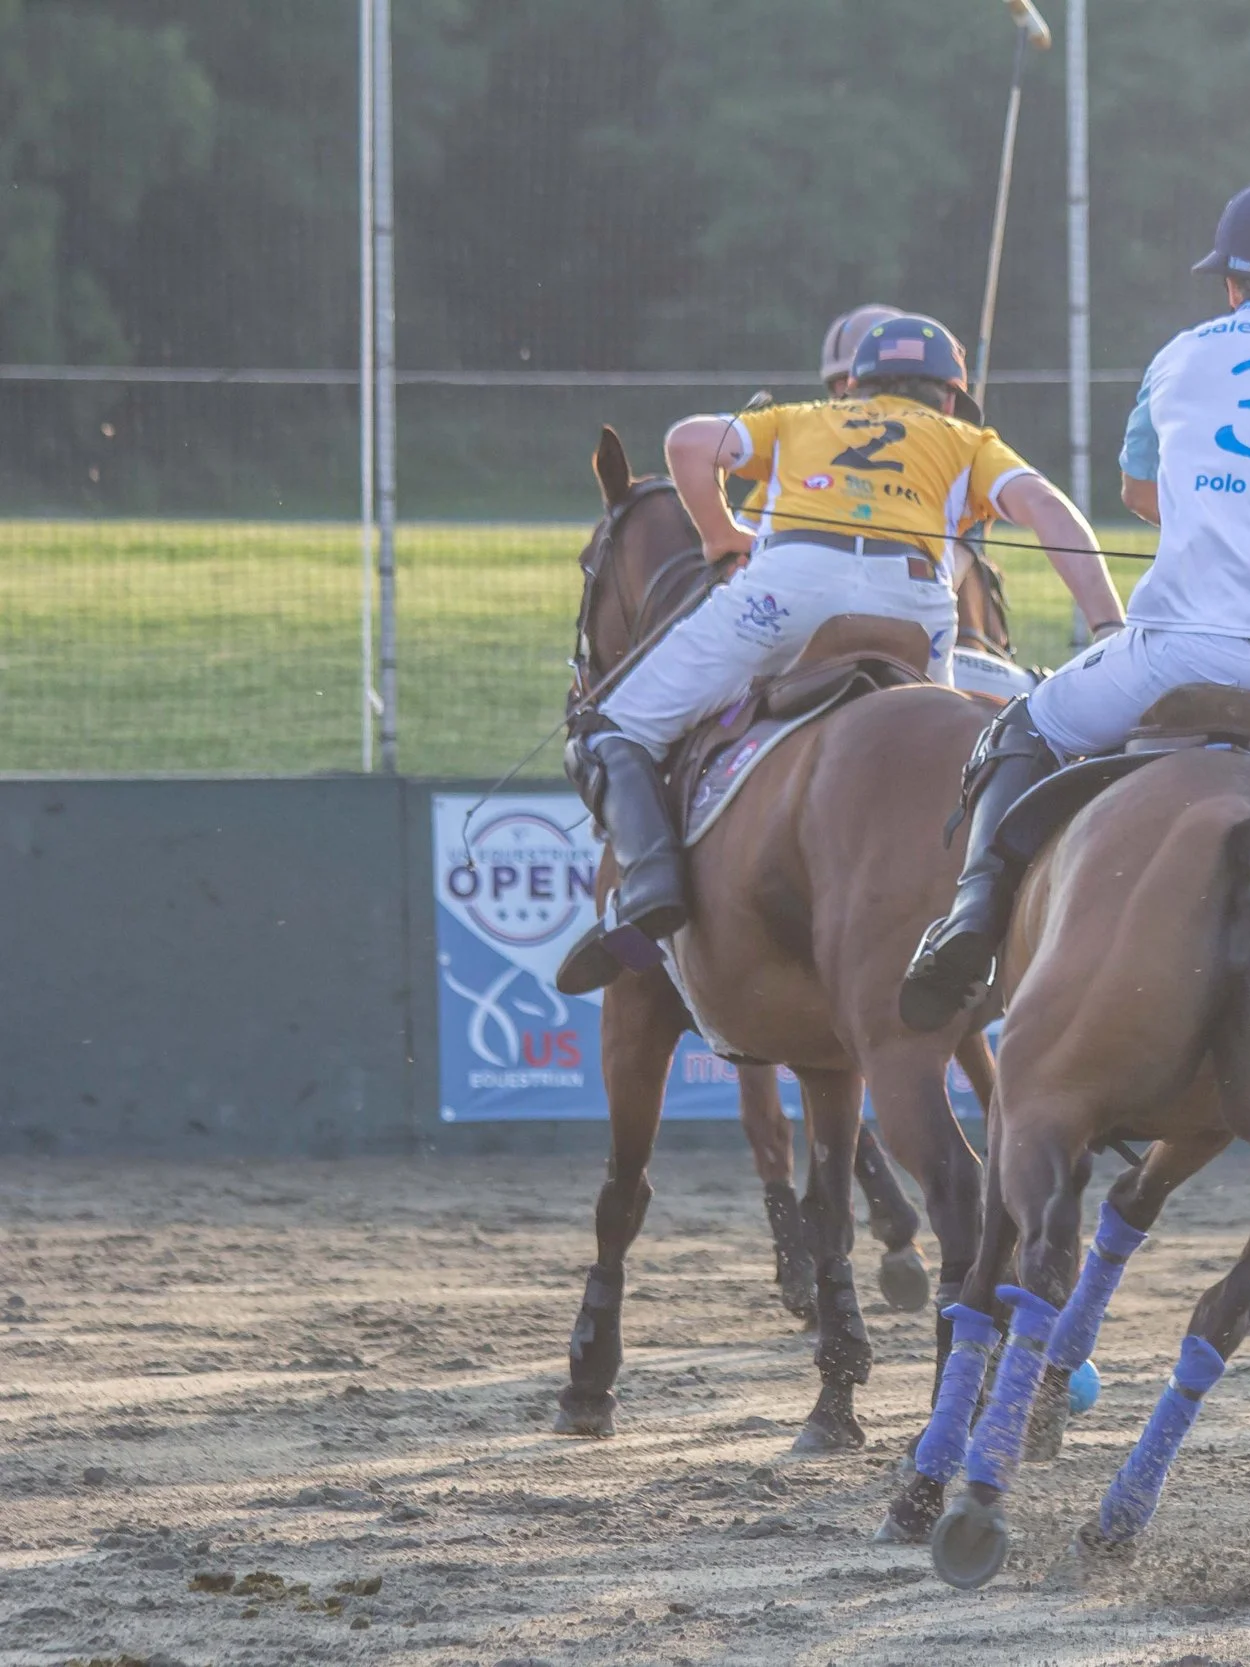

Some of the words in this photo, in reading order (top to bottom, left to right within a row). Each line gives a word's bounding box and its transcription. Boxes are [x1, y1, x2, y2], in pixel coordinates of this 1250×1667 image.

[831, 419, 907, 473] 2
[1194, 473, 1247, 494] polo
[448, 864, 596, 901] OPEN
[522, 1030, 582, 1069] US
[469, 1072, 585, 1089] EQUESTRIAN
